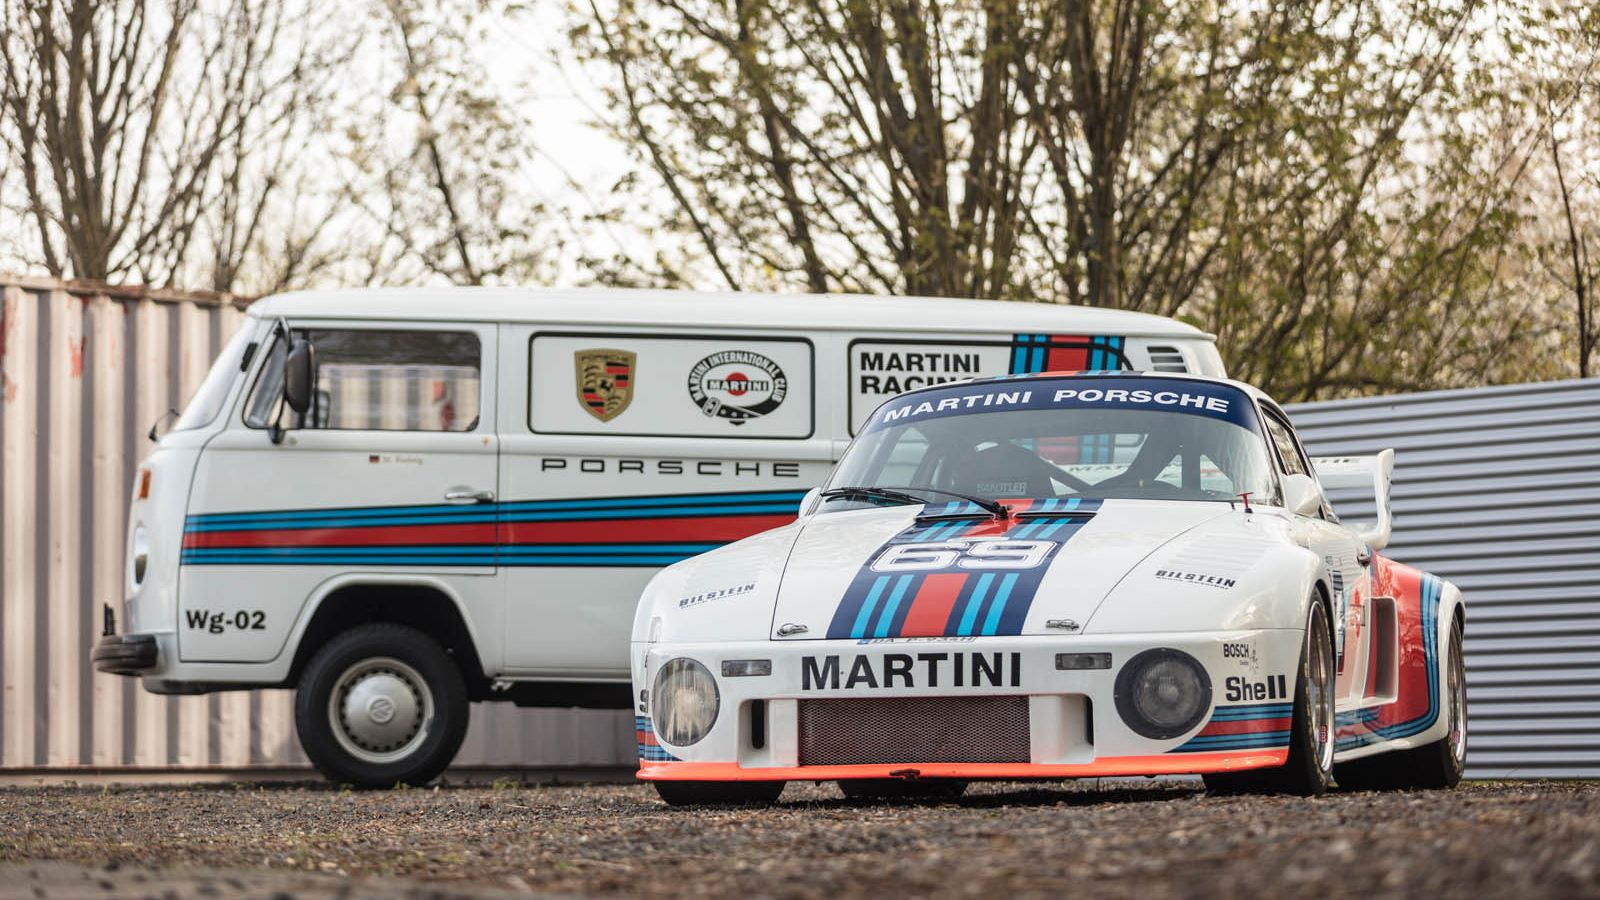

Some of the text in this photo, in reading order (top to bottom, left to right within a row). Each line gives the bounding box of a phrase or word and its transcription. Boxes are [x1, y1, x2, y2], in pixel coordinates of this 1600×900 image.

[860, 352, 980, 373] MARTINI
[708, 350, 780, 378] INTERNATIONAL
[771, 377, 787, 402] CLUB
[708, 379, 769, 392] MARTINI
[860, 375, 975, 395] RAC
[883, 389, 1230, 423] MARTINI PORSCHE
[541, 458, 800, 477] PORSCHE
[870, 541, 1058, 573] 69
[1155, 569, 1236, 588] BILSTEIN
[679, 583, 755, 608] BILSTEIN
[186, 610, 266, 634] Wg-02
[1223, 643, 1249, 658] BOSCH
[801, 652, 1021, 690] MARTINI
[1225, 674, 1286, 702] Shell
